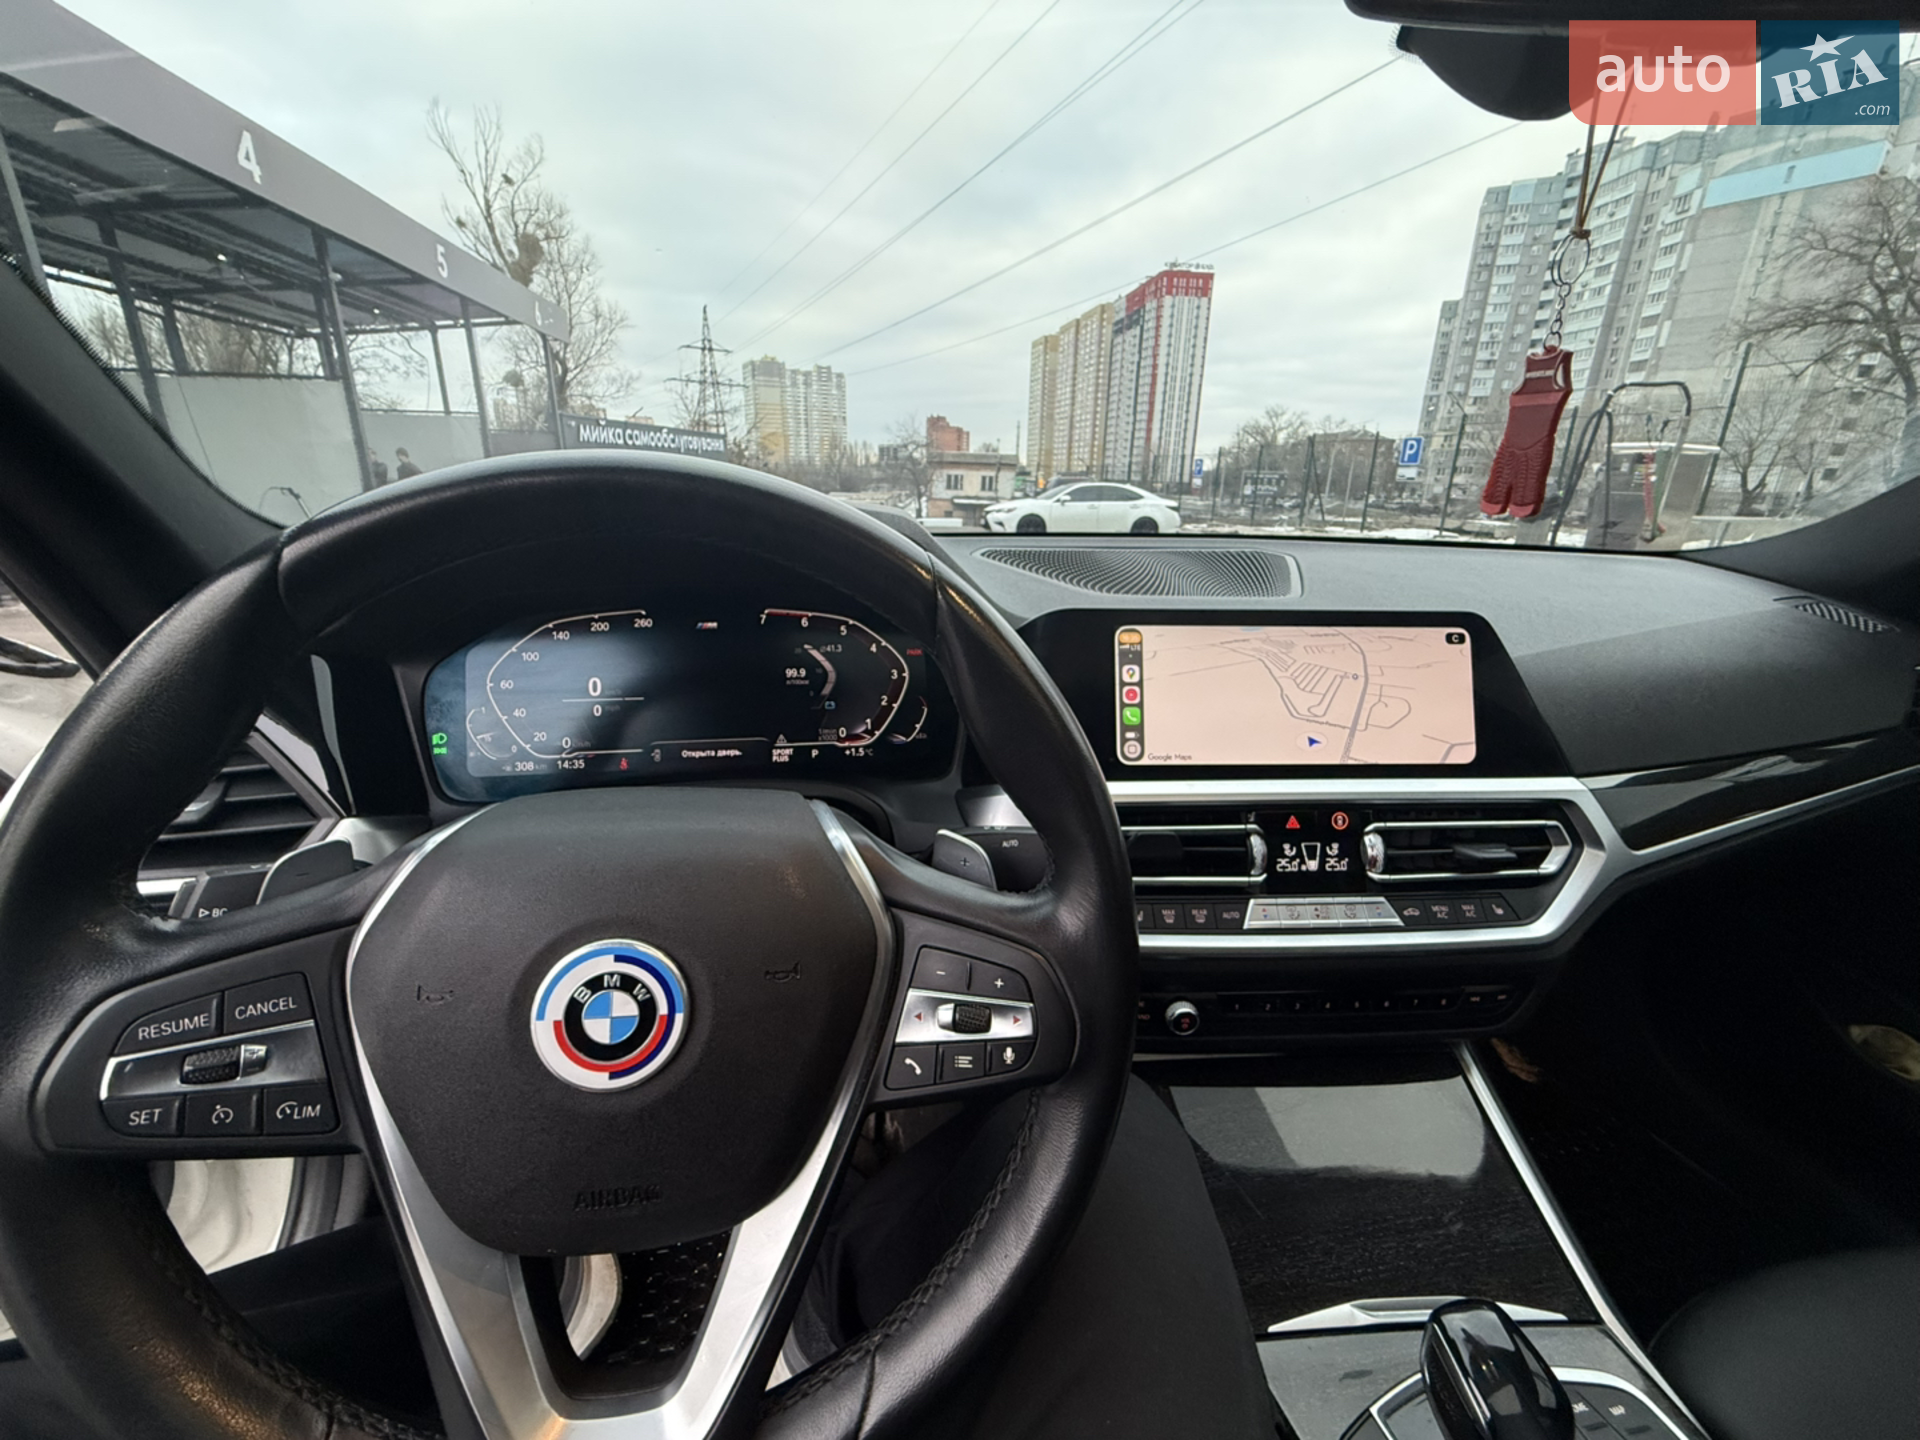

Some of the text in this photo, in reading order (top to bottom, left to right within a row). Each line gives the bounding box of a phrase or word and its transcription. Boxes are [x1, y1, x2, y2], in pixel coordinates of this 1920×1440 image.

[237, 130, 262, 184] 4
[436, 244, 448, 278] 5
[535, 300, 542, 326] 6
[1404, 440, 1418, 462] P
[633, 618, 653, 628] 260
[759, 614, 767, 625] 7
[801, 617, 809, 627] 6
[590, 621, 609, 632] 200
[840, 625, 848, 636] 5
[552, 630, 570, 640] 140
[870, 643, 877, 653] 4
[521, 651, 540, 661] 100
[785, 669, 806, 678] 99.9
[891, 669, 898, 679] 3
[500, 680, 514, 689] 60
[588, 677, 602, 697] 0
[881, 696, 888, 706] 2
[513, 708, 527, 717] 40
[593, 705, 602, 716] 0
[865, 718, 872, 730] 1
[533, 732, 547, 741] 20
[838, 727, 847, 737] 0
[562, 737, 571, 749] 0
[511, 745, 517, 753] 0
[772, 748, 794, 756] SPORT
[812, 749, 819, 758] P
[844, 748, 865, 757] +1.5
[681, 750, 715, 759] Открыта
[1147, 753, 1172, 762] Google
[515, 762, 534, 771] 308
[557, 759, 585, 770] 14:35
[1002, 839, 1019, 848] AUTO
[1161, 908, 1176, 916] MAX
[1222, 911, 1241, 920] AUTO
[573, 973, 651, 1004] BMW
[234, 996, 298, 1020] CANCEL
[138, 1013, 210, 1041] RESUME
[293, 1104, 321, 1118] LIM
[128, 1108, 162, 1126] SET
[573, 1184, 660, 1212] AIRBAG
[1608, 1404, 1626, 1416] MAP
